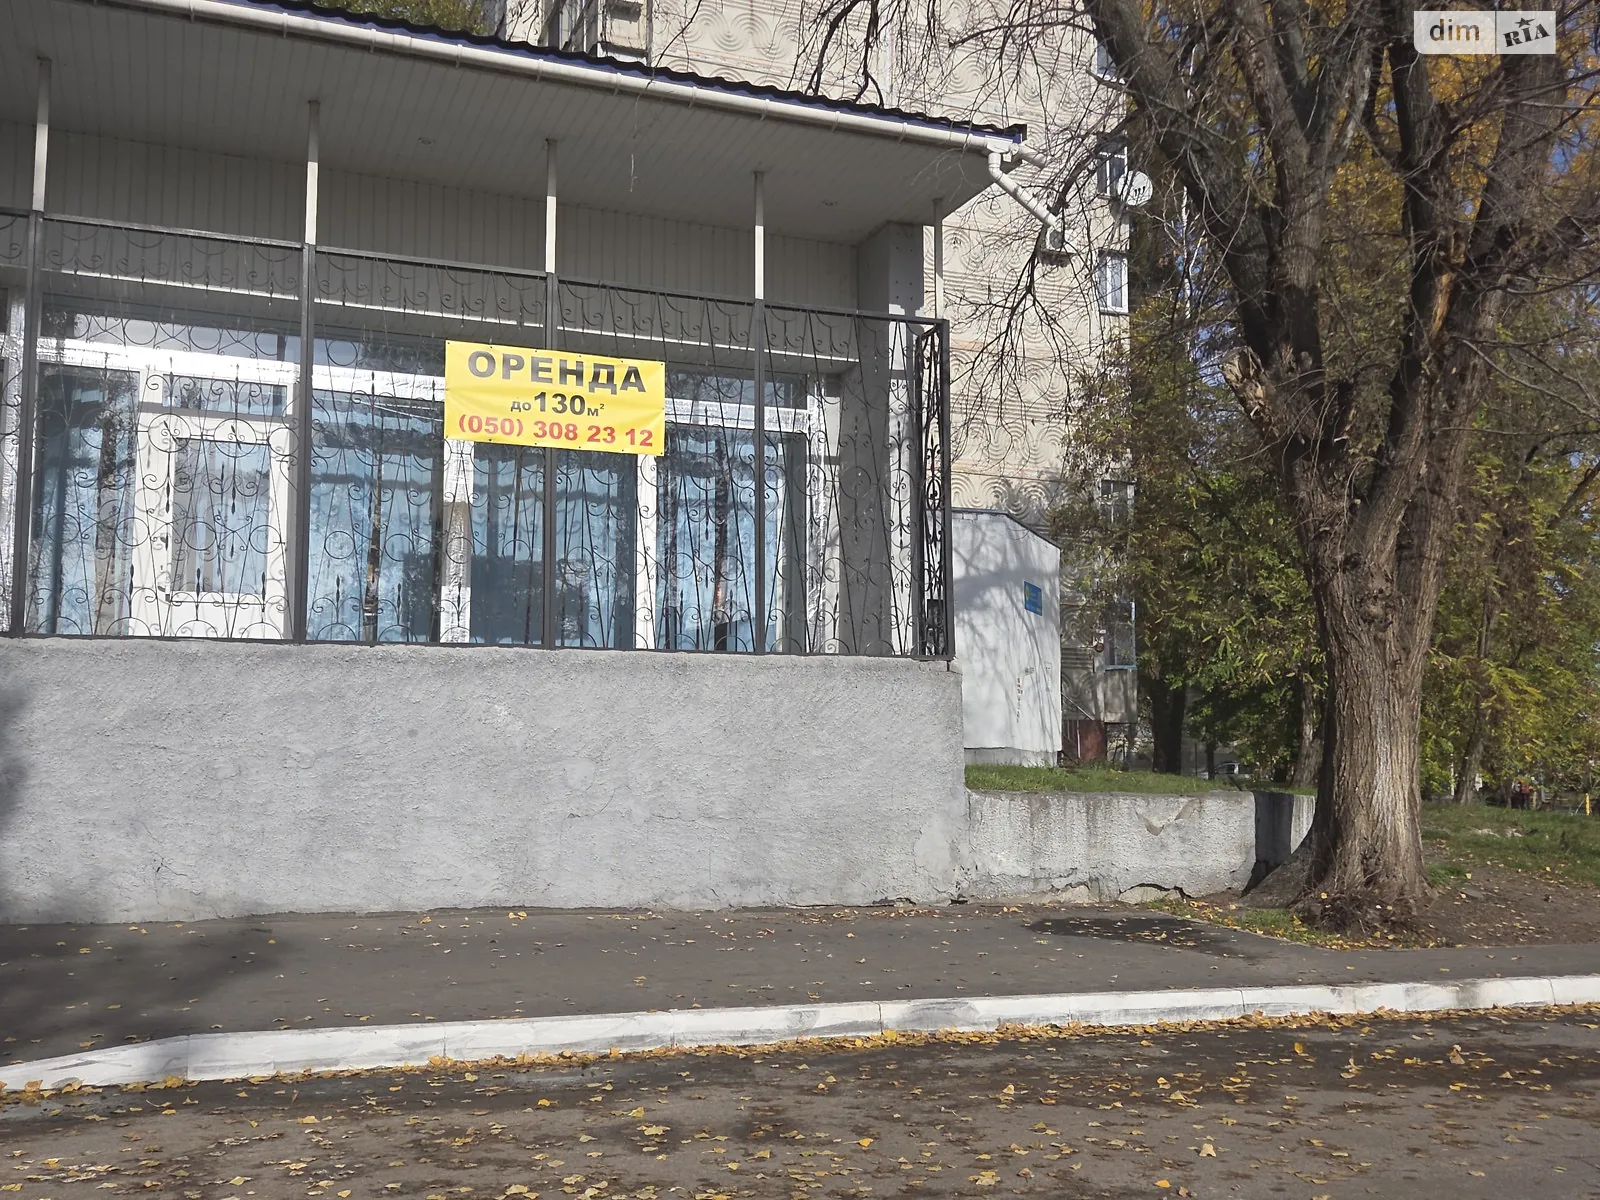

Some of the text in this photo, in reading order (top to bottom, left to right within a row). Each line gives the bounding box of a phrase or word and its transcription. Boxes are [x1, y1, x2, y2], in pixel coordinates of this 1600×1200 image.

[468, 351, 647, 395] ОРЕНДА
[458, 414, 654, 447] (050) 308 23 12
